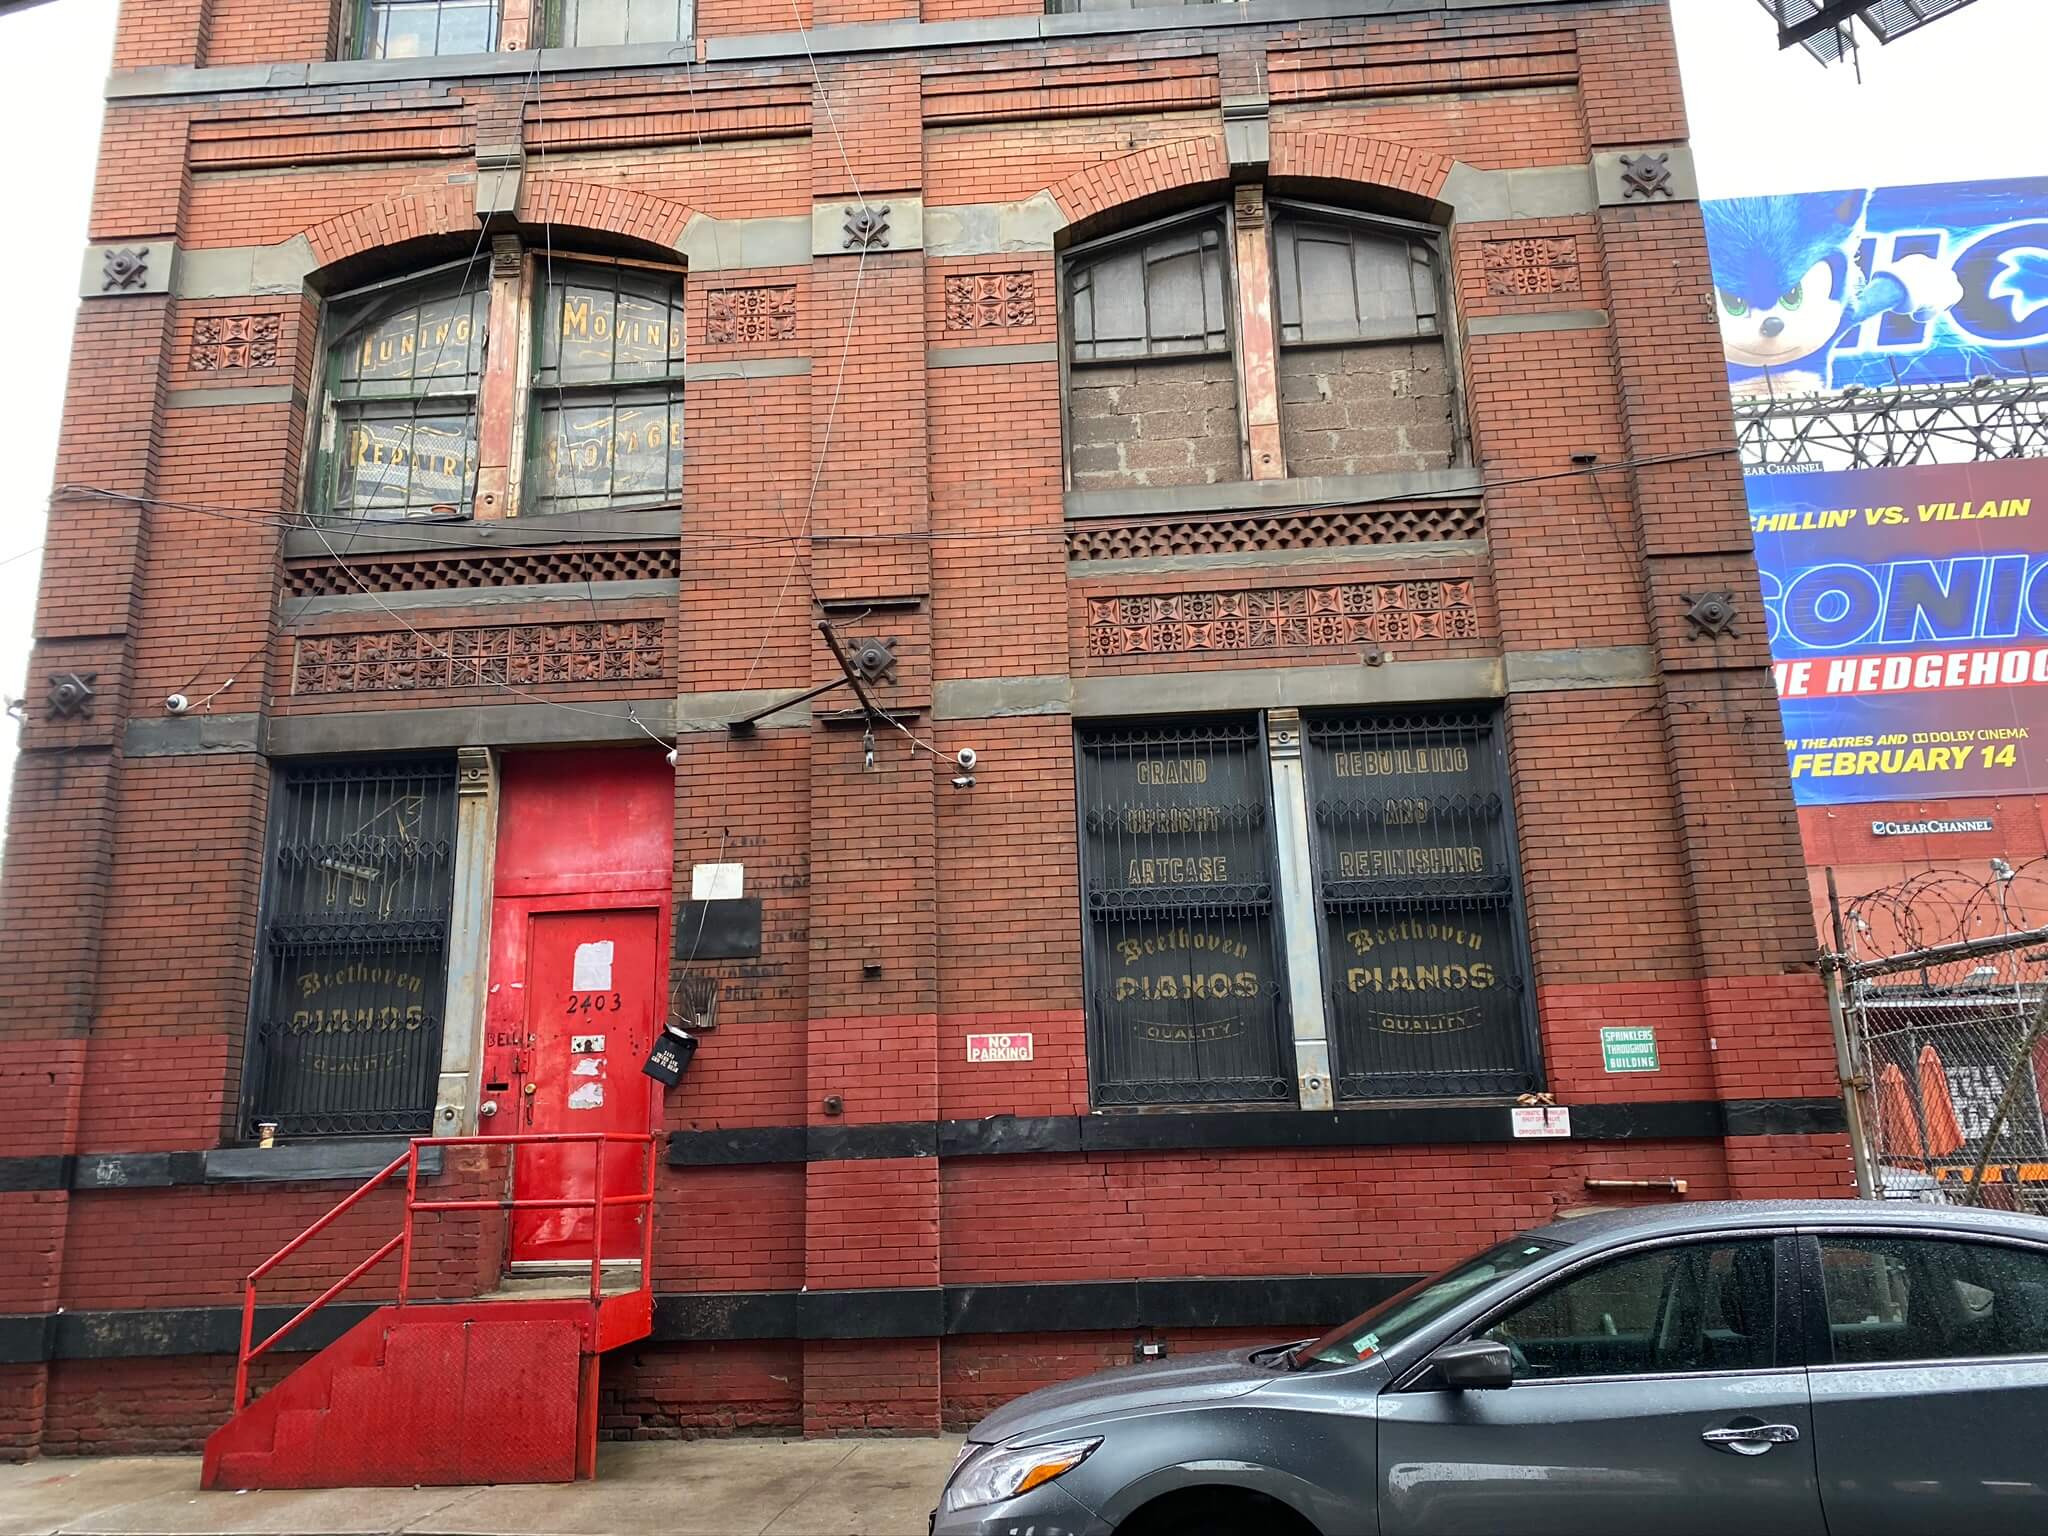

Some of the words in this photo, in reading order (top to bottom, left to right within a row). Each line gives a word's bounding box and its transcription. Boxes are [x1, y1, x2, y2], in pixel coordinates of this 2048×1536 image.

[562, 302, 680, 348] MOVING
[351, 430, 473, 481] REPAIRS
[1864, 505, 1911, 526] VS.
[1917, 498, 2031, 523] VILLAIN
[1758, 553, 2048, 650] ONI
[1801, 735, 1873, 750] THEATRES
[1877, 734, 1908, 746] AND
[1930, 730, 1976, 743] DOLBY
[1137, 759, 1207, 784] GRAND
[1335, 747, 1469, 777] REBUILDING
[1790, 745, 1975, 780] FEBRUARY
[1981, 744, 2017, 769] 14
[1128, 806, 1220, 833] UPRIGHT
[1385, 799, 1429, 825] AND
[1128, 856, 1227, 884] ARTCASE
[1339, 847, 1484, 877] REFINISHING
[1116, 928, 1249, 967] Beethoven
[1347, 918, 1483, 956] Beethoven
[1115, 971, 1260, 1002] PIANOS
[1346, 962, 1496, 993] PIANOS
[565, 993, 622, 1015] 2403
[292, 1005, 423, 1034] PIANOS
[1147, 1022, 1231, 1039] QUALITY
[1382, 1015, 1466, 1030] QUALITY
[972, 1047, 1028, 1060] PARKING
[988, 1036, 1012, 1048] NO
[1609, 1056, 1655, 1068] BUILDING
